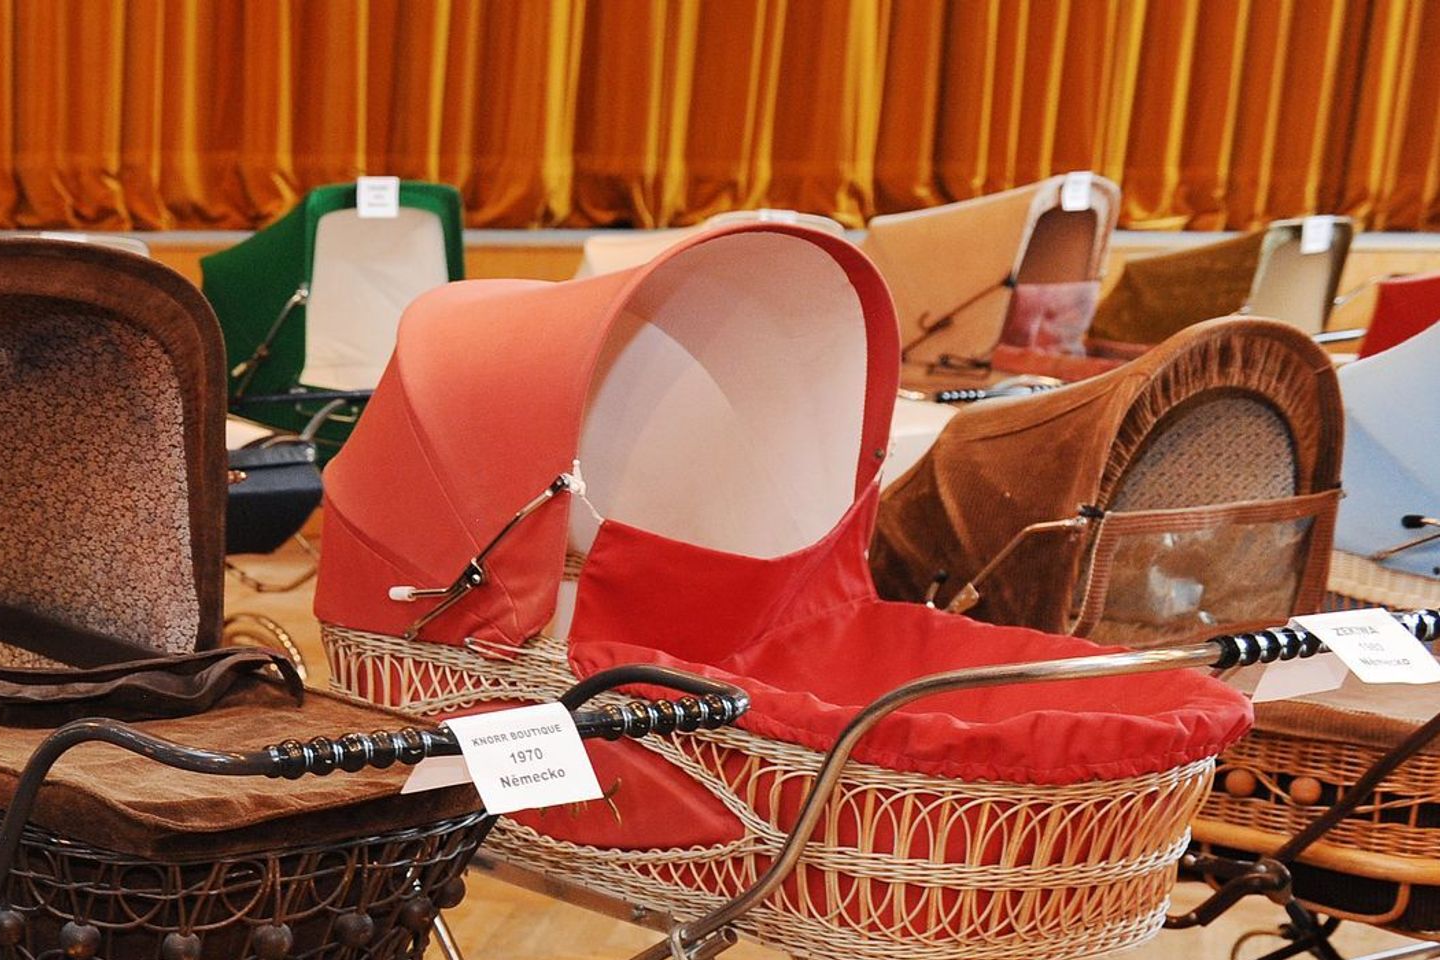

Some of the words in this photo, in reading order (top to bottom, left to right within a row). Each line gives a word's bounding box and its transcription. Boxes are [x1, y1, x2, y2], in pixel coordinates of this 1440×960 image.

[471, 733, 508, 747] KNORR
[511, 724, 562, 741] BOUTIQUE
[510, 747, 543, 764] 1970
[500, 768, 566, 789] Německo
